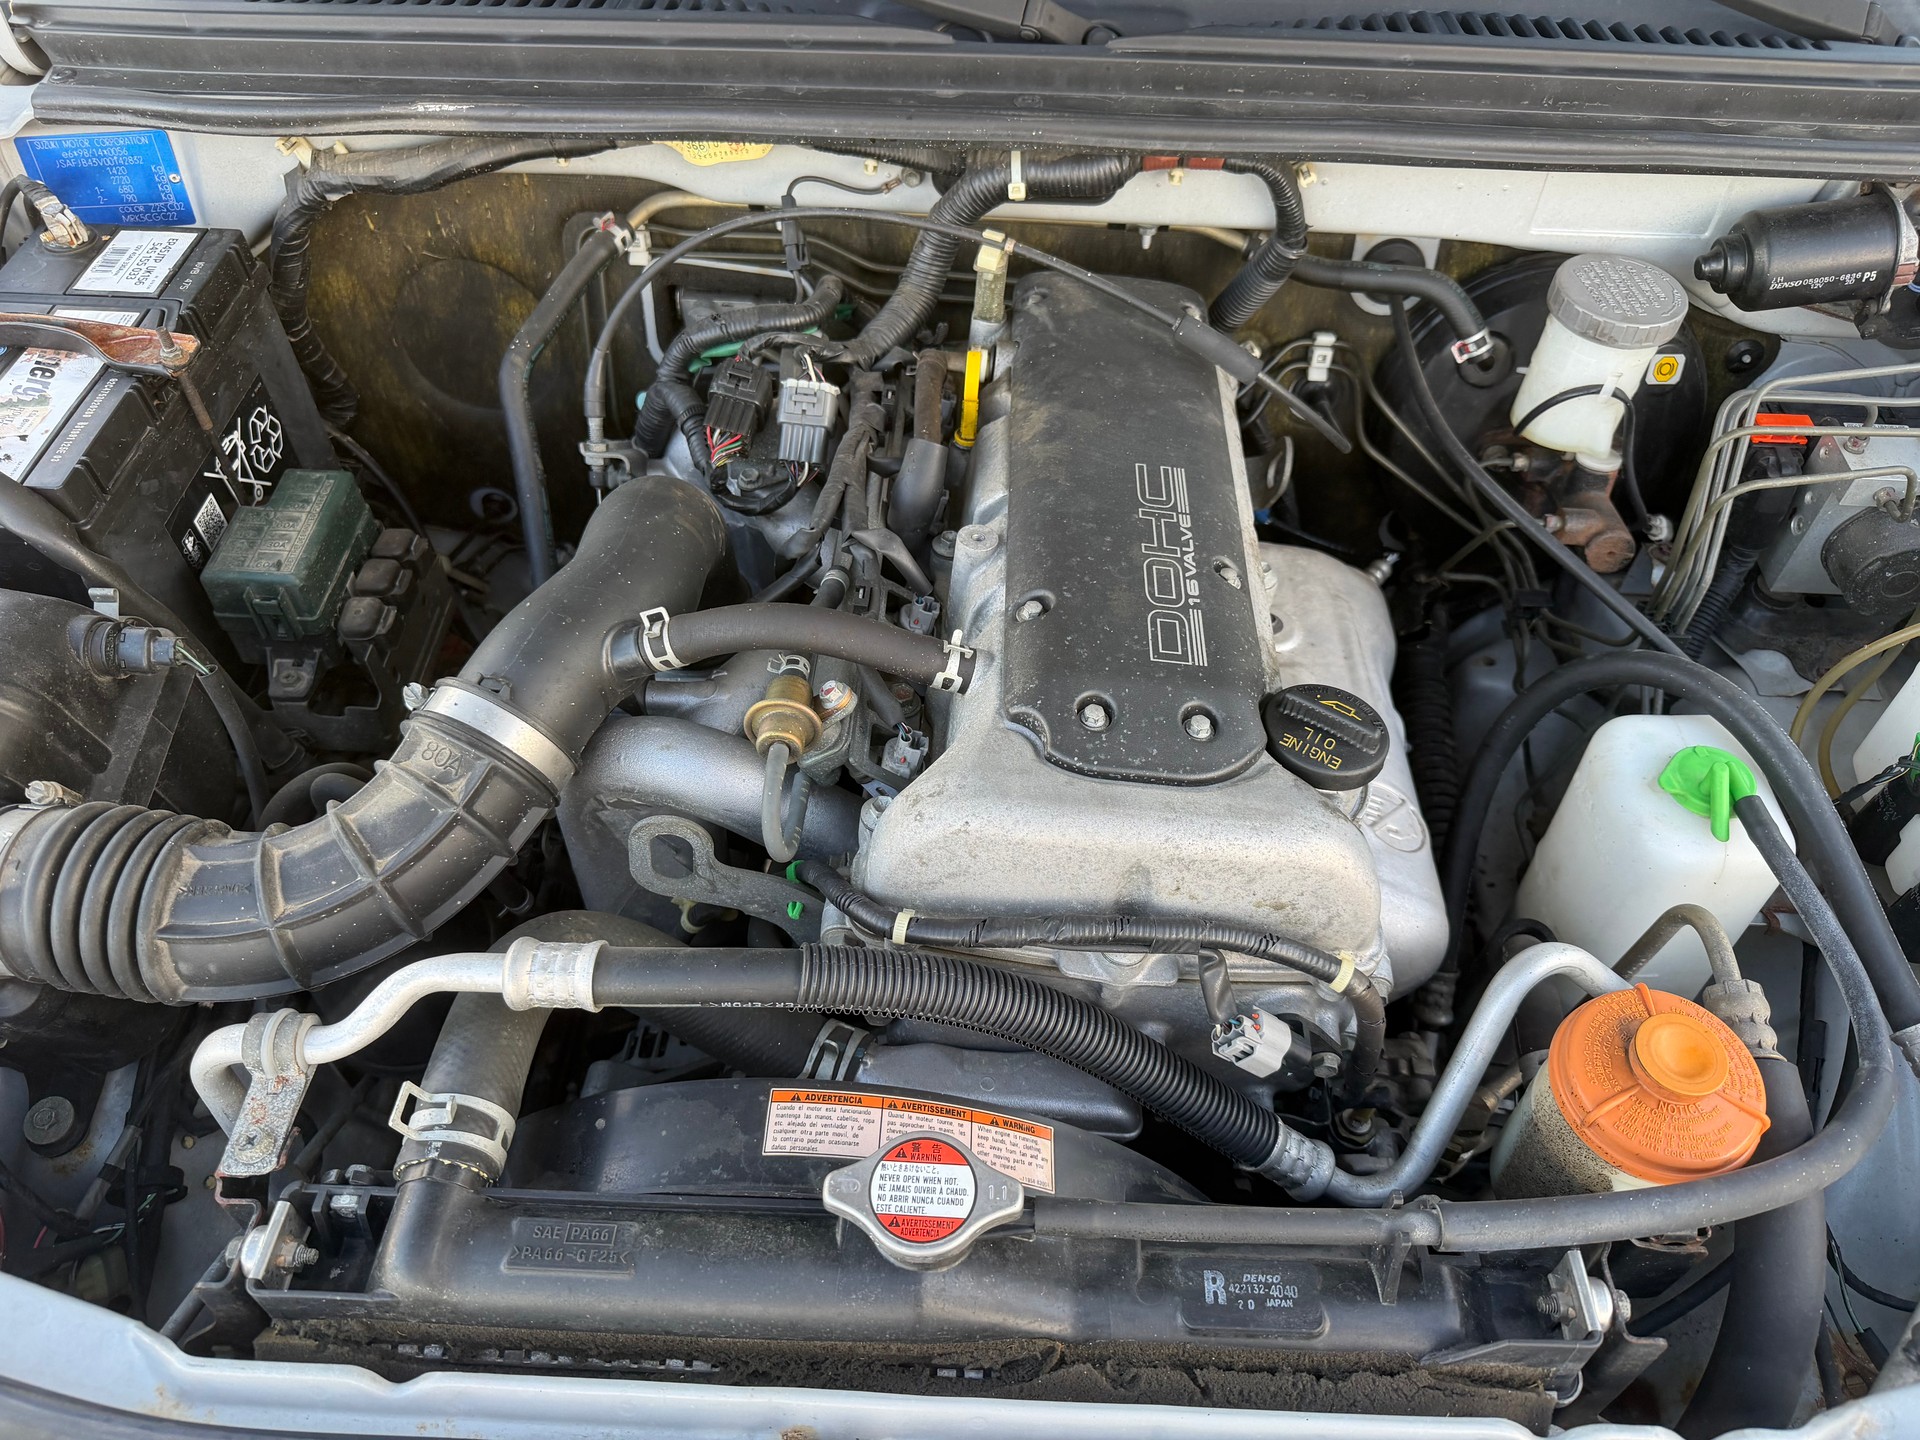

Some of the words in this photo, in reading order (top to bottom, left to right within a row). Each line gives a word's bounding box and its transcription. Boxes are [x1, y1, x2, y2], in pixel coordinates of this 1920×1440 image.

[34, 140, 59, 150] SUZUKI
[61, 138, 90, 149] MOTOR
[94, 135, 149, 147] CORPORATION
[106, 166, 128, 175] 1420
[151, 164, 164, 175] Kg
[110, 175, 131, 185] 2720
[154, 174, 167, 184] Kg
[118, 184, 134, 194] 680
[157, 183, 170, 193] Kg
[121, 193, 138, 203] 790
[161, 192, 174, 203] Kg
[119, 205, 145, 214] COLOR
[147, 242, 163, 255] 545
[140, 255, 150, 267] 155
[126, 267, 140, 280] 033
[1769, 280, 1803, 291] DENSO
[1862, 270, 1878, 283] P5
[1135, 463, 1192, 665] DOHC
[1304, 726, 1337, 750] OIL
[421, 740, 463, 777] 80A
[1279, 733, 1342, 771] ENGINE
[804, 1093, 863, 1105] ADVERTENCIA
[839, 1107, 872, 1116] funcionando
[901, 1101, 967, 1119] AVERTISSEMENT
[1637, 1101, 1651, 1111] Use
[1651, 1108, 1669, 1121] Only
[1702, 1106, 1721, 1121] Power
[1657, 1100, 1704, 1116] NOTICE
[775, 1112, 801, 1120] mantenga
[887, 1111, 905, 1119] Quand
[915, 1115, 934, 1123] moteur
[1630, 1106, 1665, 1130] Steering
[787, 1120, 807, 1128] alejado
[820, 1122, 848, 1130] ventilador
[886, 1120, 897, 1128] pas
[899, 1121, 926, 1131] approcher
[927, 1123, 936, 1132] les
[958, 1129, 966, 1137] les
[977, 1125, 993, 1134] When
[994, 1129, 1011, 1138] engine
[1624, 1110, 1640, 1125] Fill
[1643, 1122, 1662, 1135] fluid
[1690, 1132, 1713, 1144] Upper
[773, 1128, 797, 1136] cualquier
[814, 1130, 830, 1138] parte
[977, 1133, 990, 1143] keep
[1620, 1115, 1640, 1134] when
[1643, 1132, 1663, 1145] fluid
[1678, 1141, 1704, 1151] below
[828, 1139, 860, 1147] ocasionarse
[1613, 1122, 1636, 1140] Level
[1639, 1139, 1660, 1152] with
[1664, 1148, 1686, 1159] Cold
[910, 1152, 942, 1162] WARNING
[976, 1149, 990, 1157] other
[993, 1153, 1011, 1163] moving
[1012, 1157, 1026, 1165] parts
[989, 1144, 1003, 1154] away
[1005, 1147, 1017, 1155] from
[1019, 1150, 1028, 1158] fan
[1029, 1152, 1039, 1160] and
[1041, 1156, 1049, 1164] any
[879, 1173, 900, 1183] NEVER
[902, 1175, 920, 1184] OPEN
[922, 1176, 942, 1185] WHEN
[944, 1177, 959, 1186] HOT.
[878, 1183, 887, 1192] NE
[888, 1184, 912, 1194] JAMAIS
[913, 1186, 937, 1195] OUVRIR
[939, 1185, 944, 1195] À
[988, 1184, 1008, 1201] 1.1
[876, 1193, 887, 1202] NO
[888, 1194, 909, 1204] ABRIR
[911, 1196, 935, 1205] NUNCA
[936, 1197, 964, 1207] CUANDO
[876, 1203, 892, 1213] ESTE
[894, 1205, 928, 1215] CALIENTE.
[901, 1219, 955, 1230] AVERTISSEMENT
[532, 1225, 564, 1240] SAE
[570, 1226, 609, 1241] PA66
[900, 1227, 940, 1238] ADVERTENCIA
[1243, 1273, 1282, 1284] DENSO
[1203, 1269, 1227, 1305] R
[1228, 1283, 1299, 1299] 422132-4040
[1265, 1298, 1294, 1308] JAPAN
